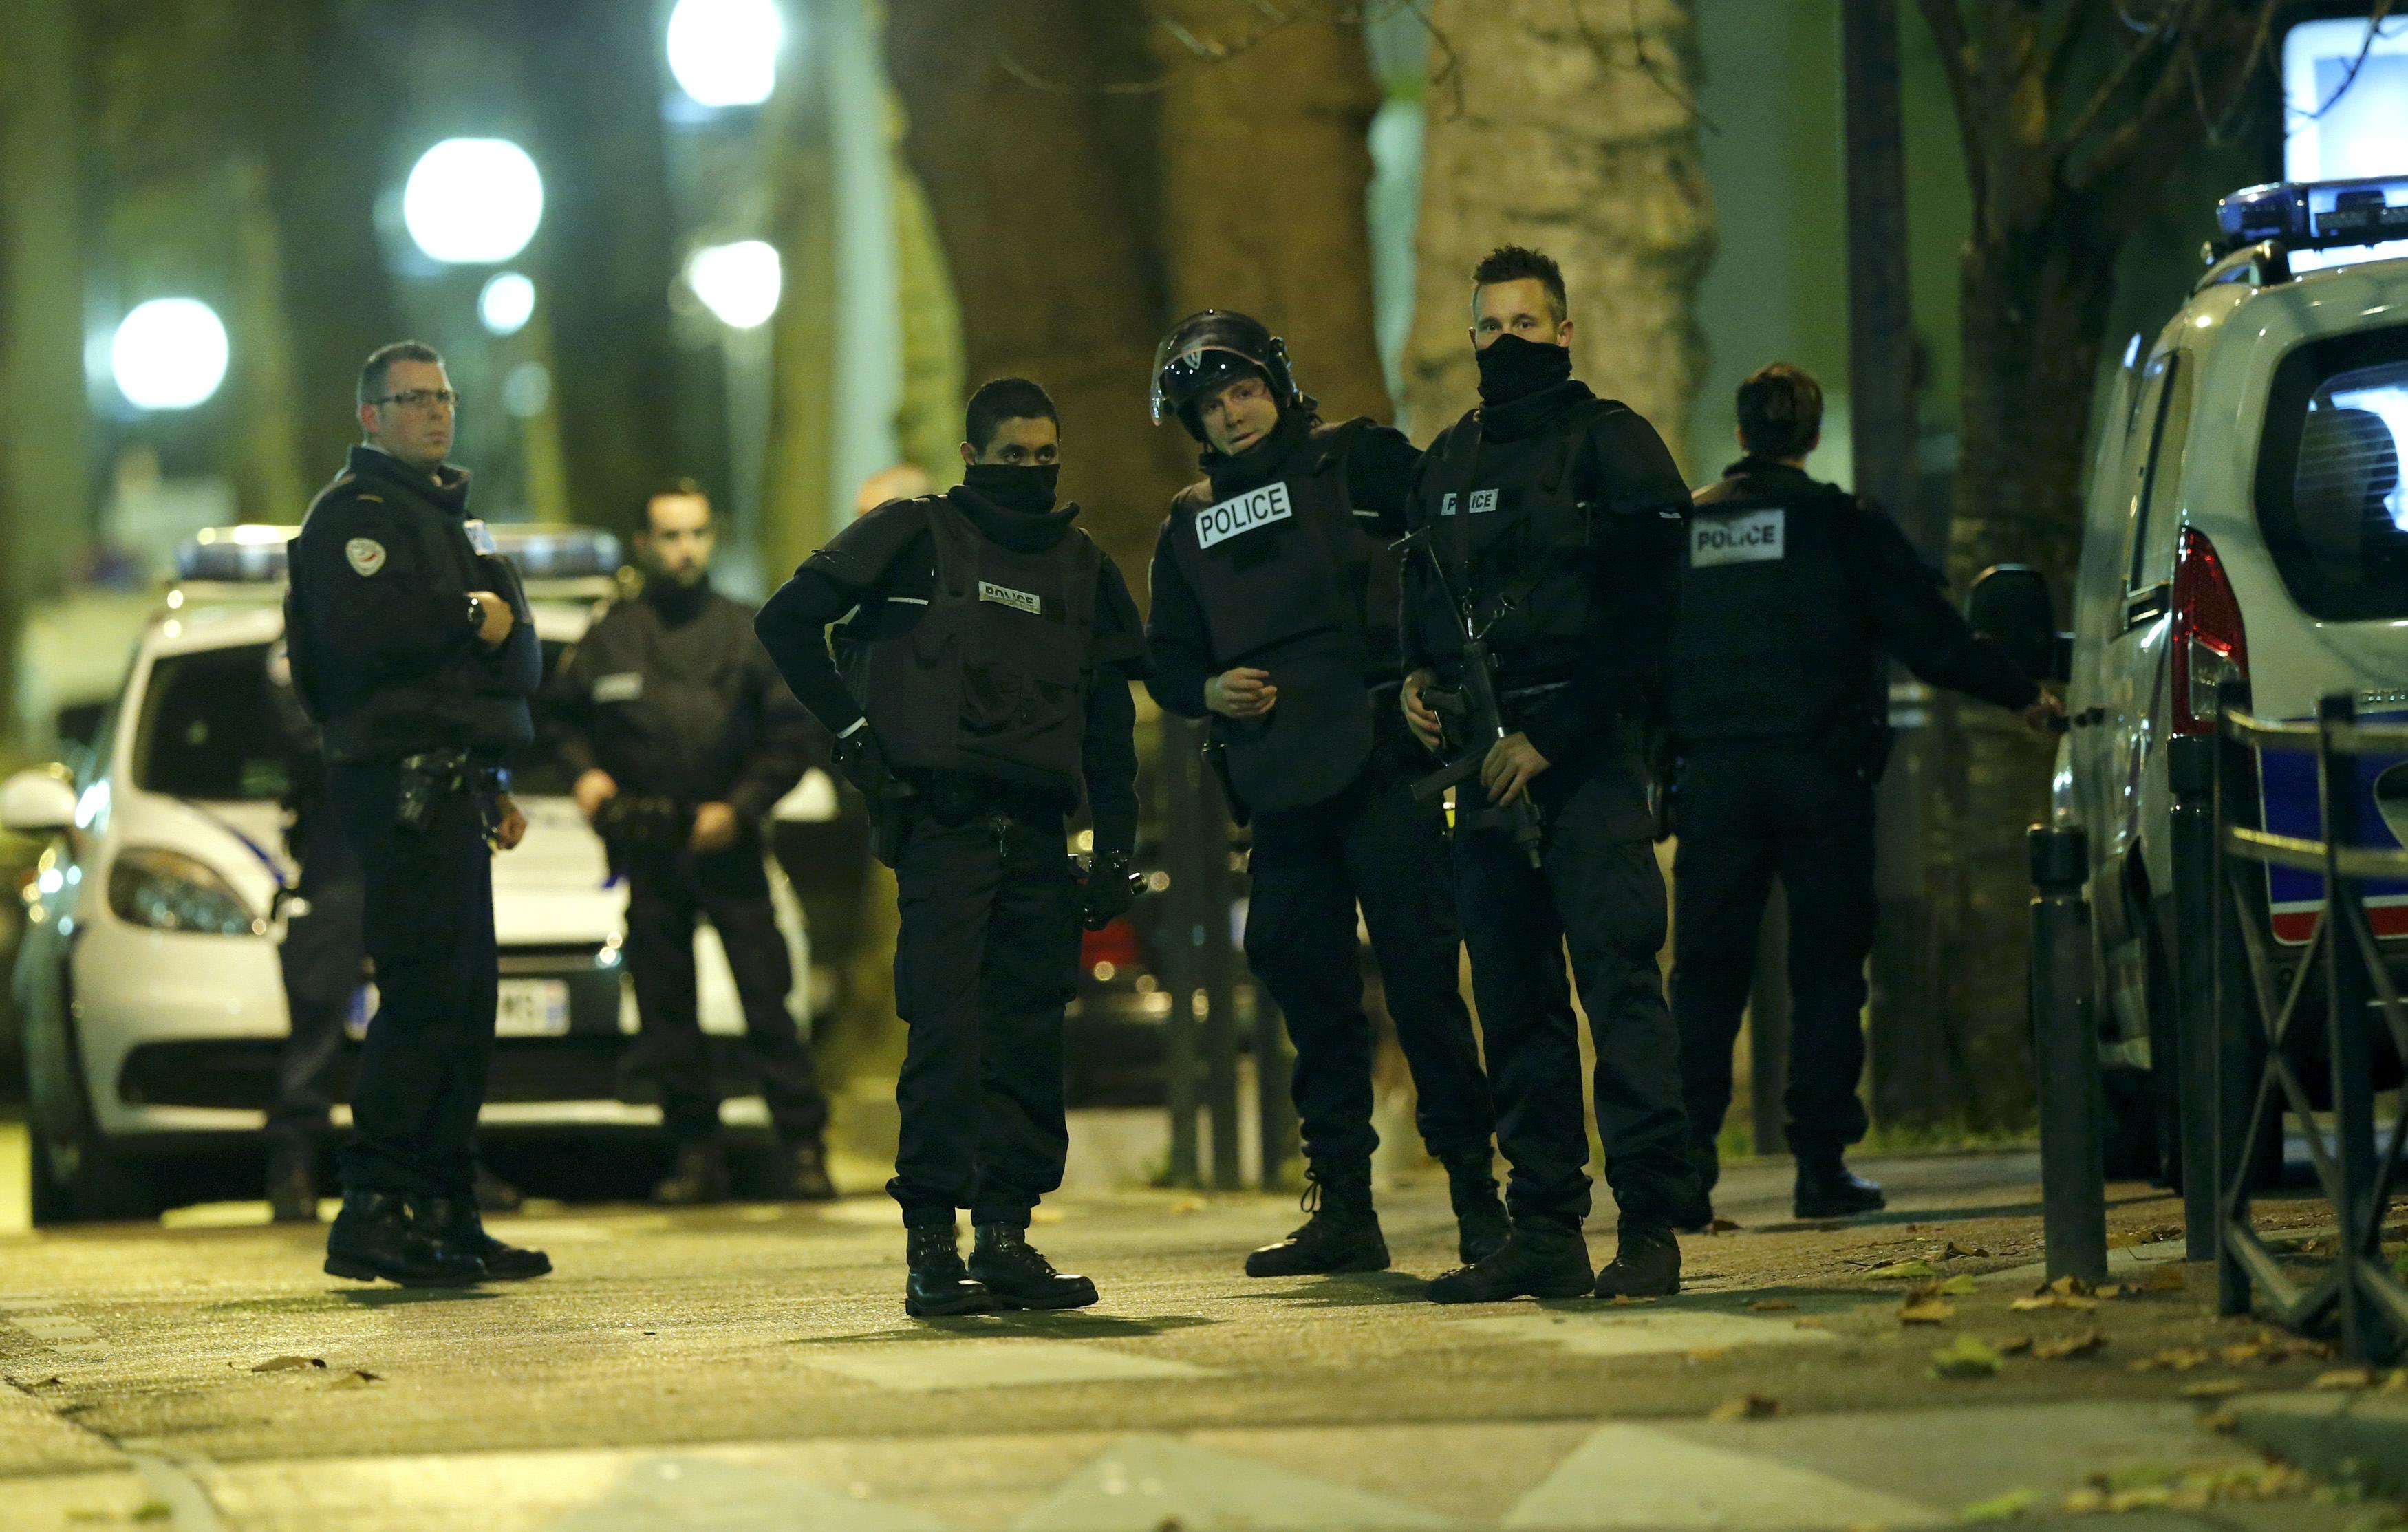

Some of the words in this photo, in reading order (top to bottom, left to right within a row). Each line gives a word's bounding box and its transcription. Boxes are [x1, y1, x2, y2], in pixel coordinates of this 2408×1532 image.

[1447, 493, 1492, 510] PICE
[1201, 488, 1285, 542] POLICE
[1697, 525, 1775, 551] POLICE
